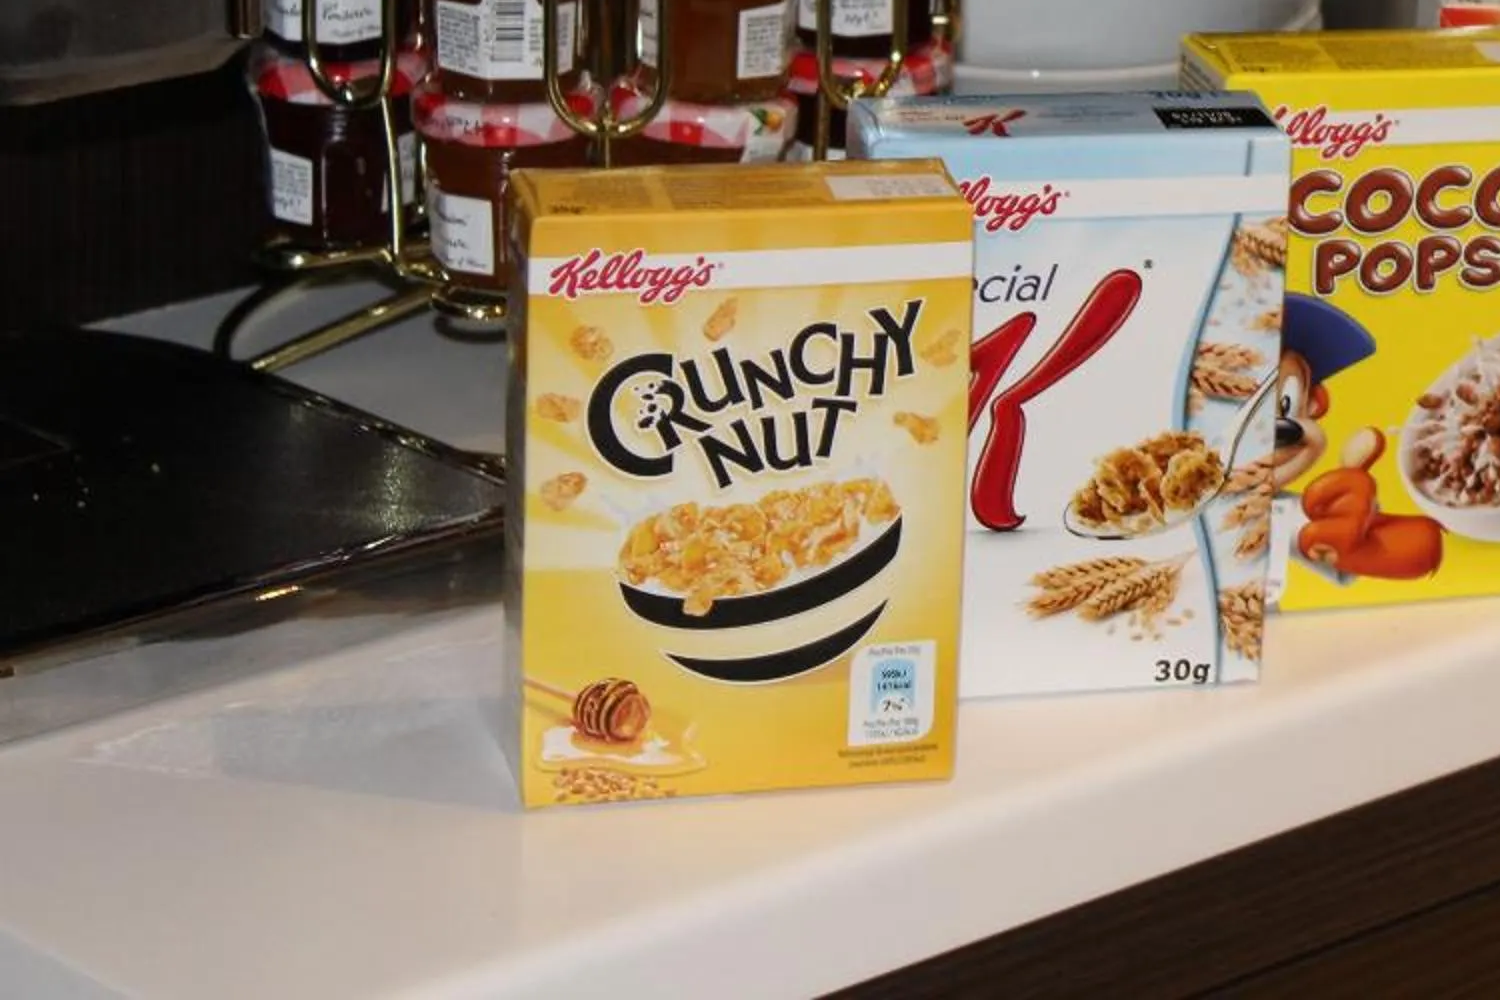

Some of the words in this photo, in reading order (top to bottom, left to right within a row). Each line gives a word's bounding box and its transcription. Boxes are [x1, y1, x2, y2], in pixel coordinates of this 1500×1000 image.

[548, 249, 716, 304] Kellogg's
[972, 264, 1059, 303] cial
[587, 299, 922, 478] CRUNCHY
[699, 397, 858, 489] NUT
[1154, 658, 1211, 686] 30g
